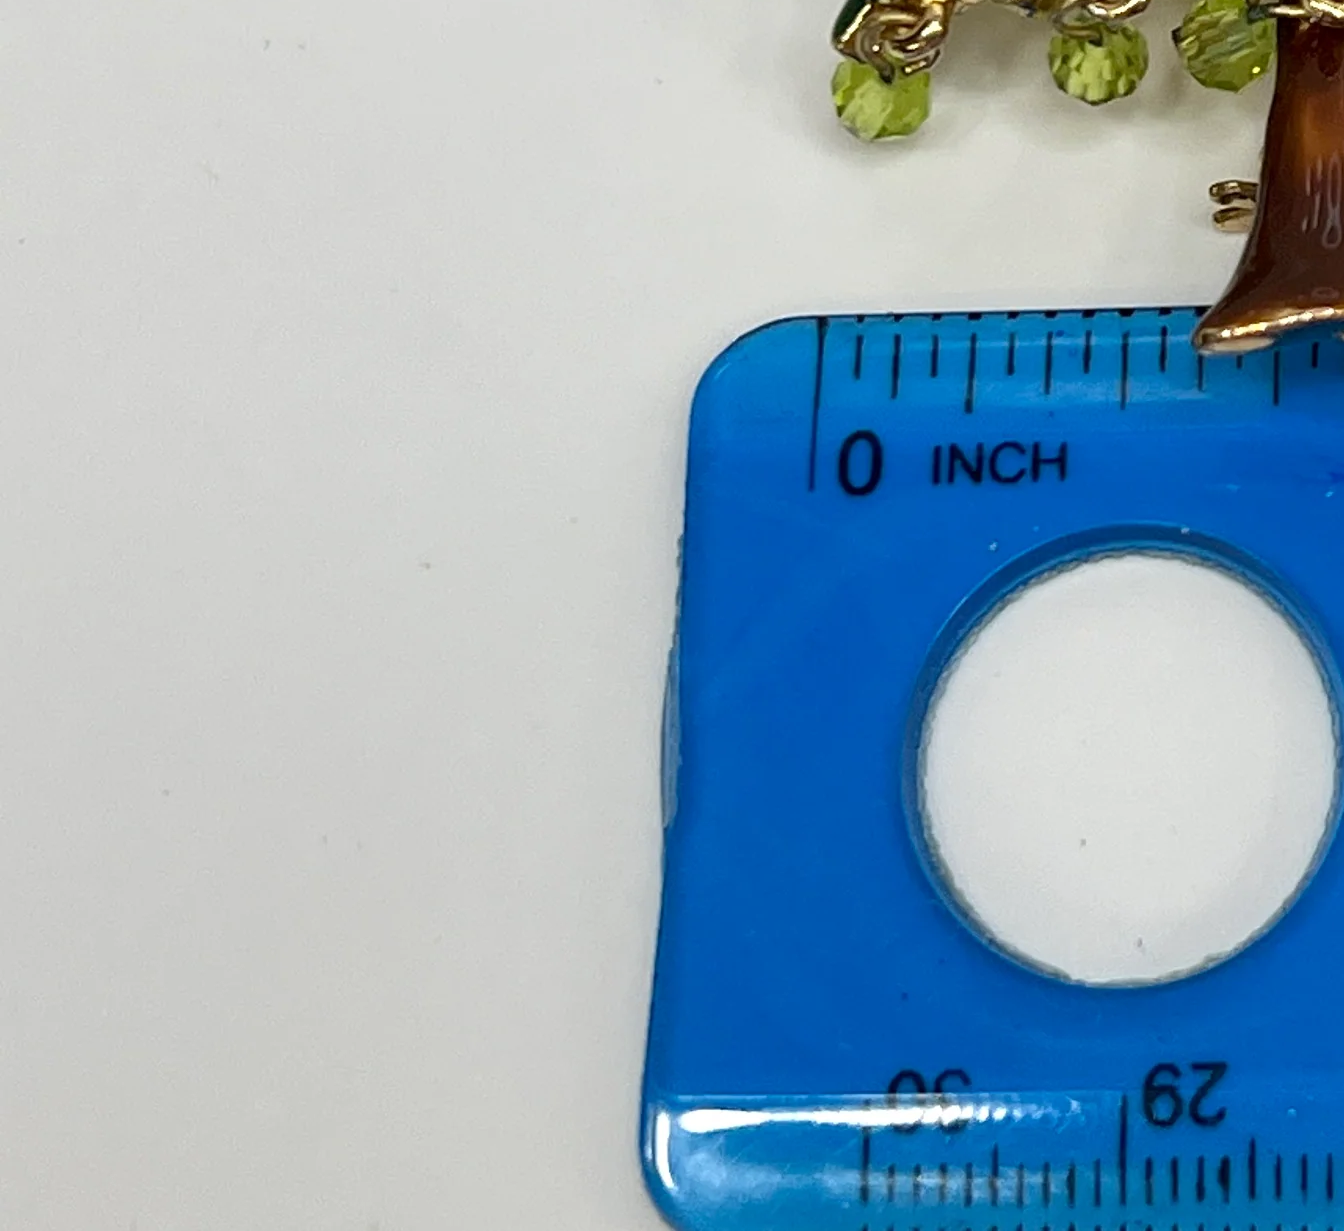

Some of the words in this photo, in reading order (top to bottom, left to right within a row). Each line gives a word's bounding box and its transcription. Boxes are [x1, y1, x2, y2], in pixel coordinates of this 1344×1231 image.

[836, 428, 884, 497] 0
[930, 440, 1069, 486] INCH
[1141, 1061, 1228, 1128] 29
